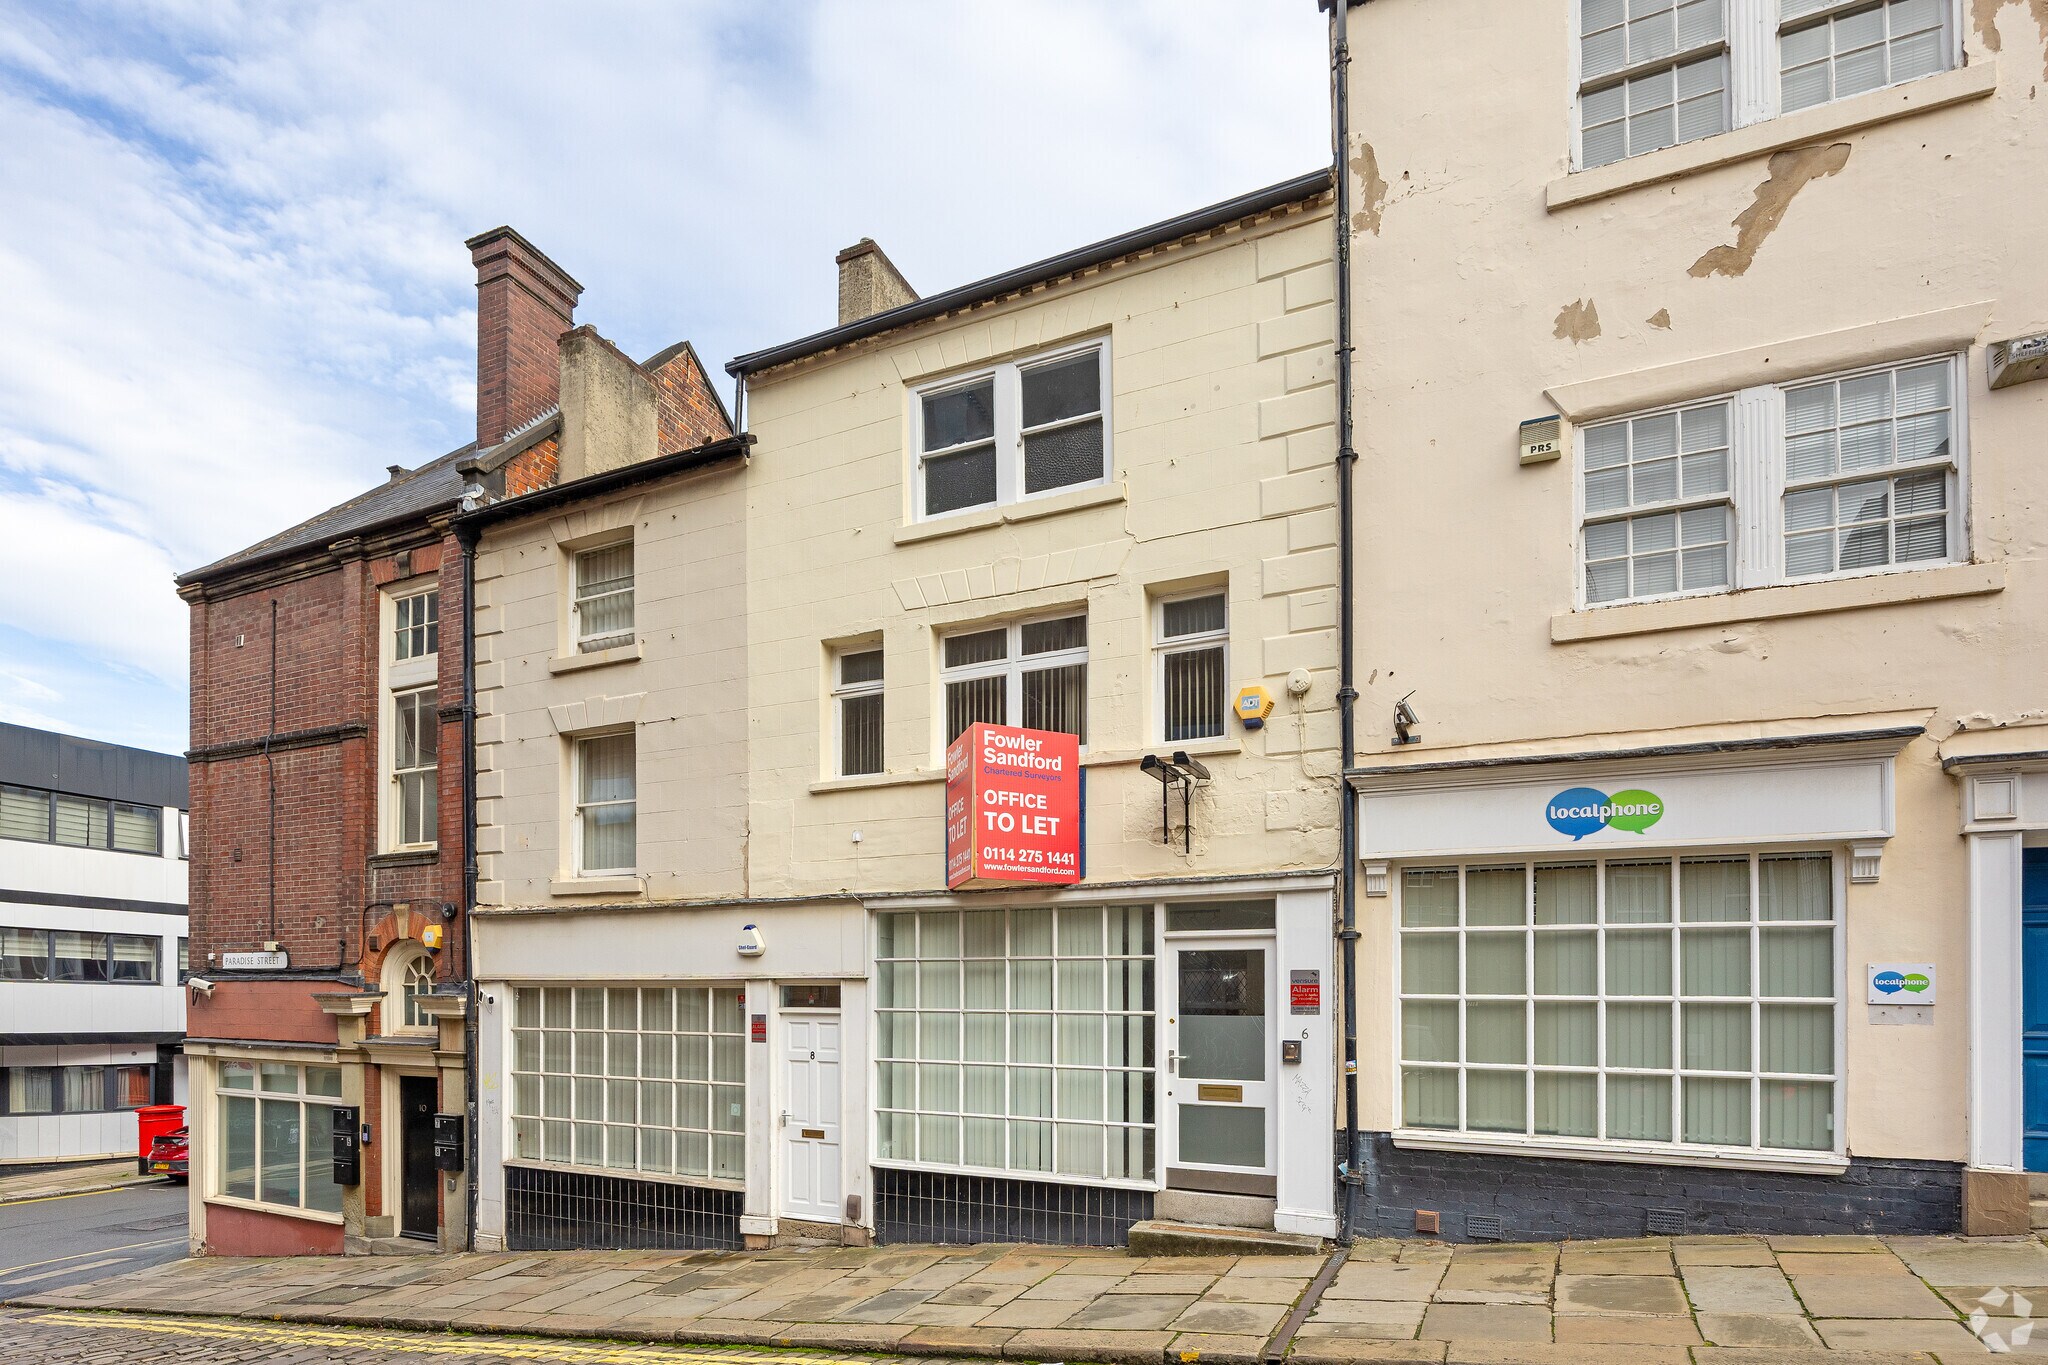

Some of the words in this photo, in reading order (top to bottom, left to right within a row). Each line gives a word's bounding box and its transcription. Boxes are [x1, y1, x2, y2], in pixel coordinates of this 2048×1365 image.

[1530, 442, 1552, 454] PRS
[1242, 697, 1260, 708] ADT
[984, 729, 1042, 752] Fowler
[984, 747, 1062, 771] Sandford
[984, 766, 1022, 777] Chartered
[1024, 770, 1062, 782] Surveyors
[984, 789, 1047, 810] OFFICE
[948, 797, 964, 821] OFFICE
[1550, 802, 1660, 824] localphone
[948, 824, 956, 845] TO
[957, 815, 967, 839] LET
[984, 811, 1015, 833] TO
[1022, 814, 1060, 836] LET
[983, 846, 1015, 861] 0114
[1018, 849, 1043, 863] 275
[1047, 851, 1075, 865] 1441
[984, 863, 1075, 876] www.fowlersandford.com
[225, 956, 254, 966] PARADISE
[257, 956, 280, 965] STREET
[1292, 985, 1319, 993] Alarm
[1875, 978, 1929, 988] localphone
[1301, 1028, 1309, 1039] 6
[810, 1051, 815, 1060] 8
[419, 1104, 427, 1112] 10
